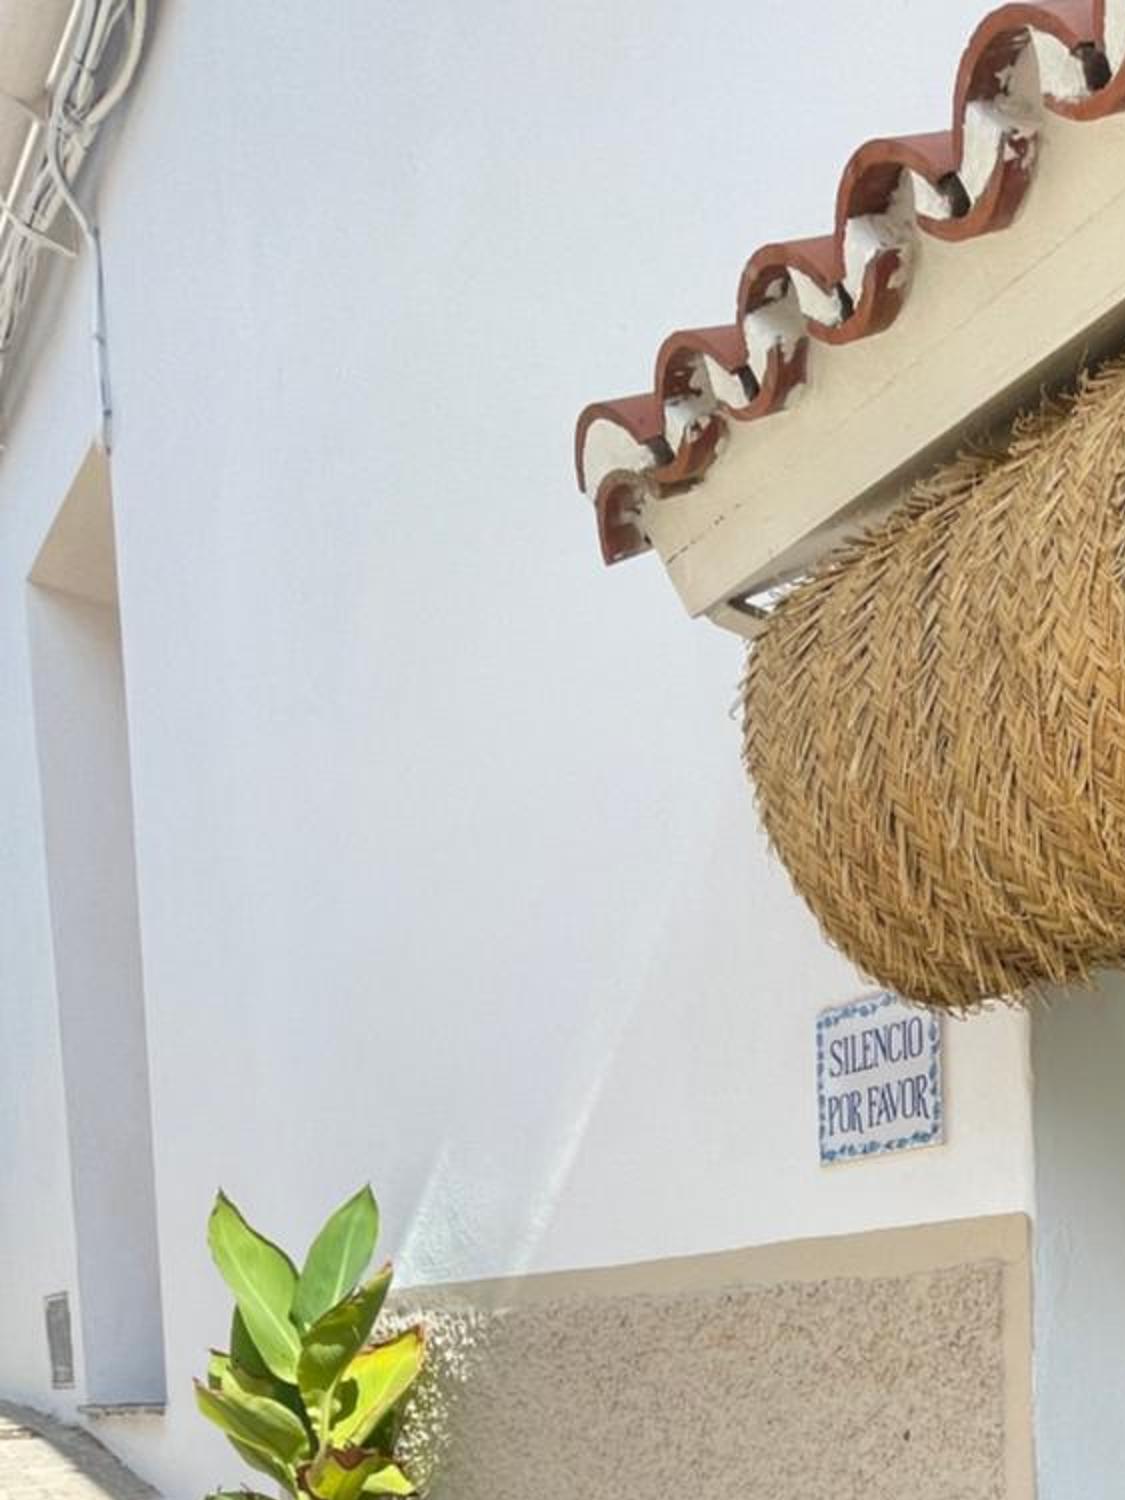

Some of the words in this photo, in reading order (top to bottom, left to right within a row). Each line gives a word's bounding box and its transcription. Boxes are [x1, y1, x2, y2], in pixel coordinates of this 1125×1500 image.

[829, 1016, 923, 1078] SILENCIO
[828, 1090, 864, 1136] POR
[867, 1074, 930, 1128] FAVOR
